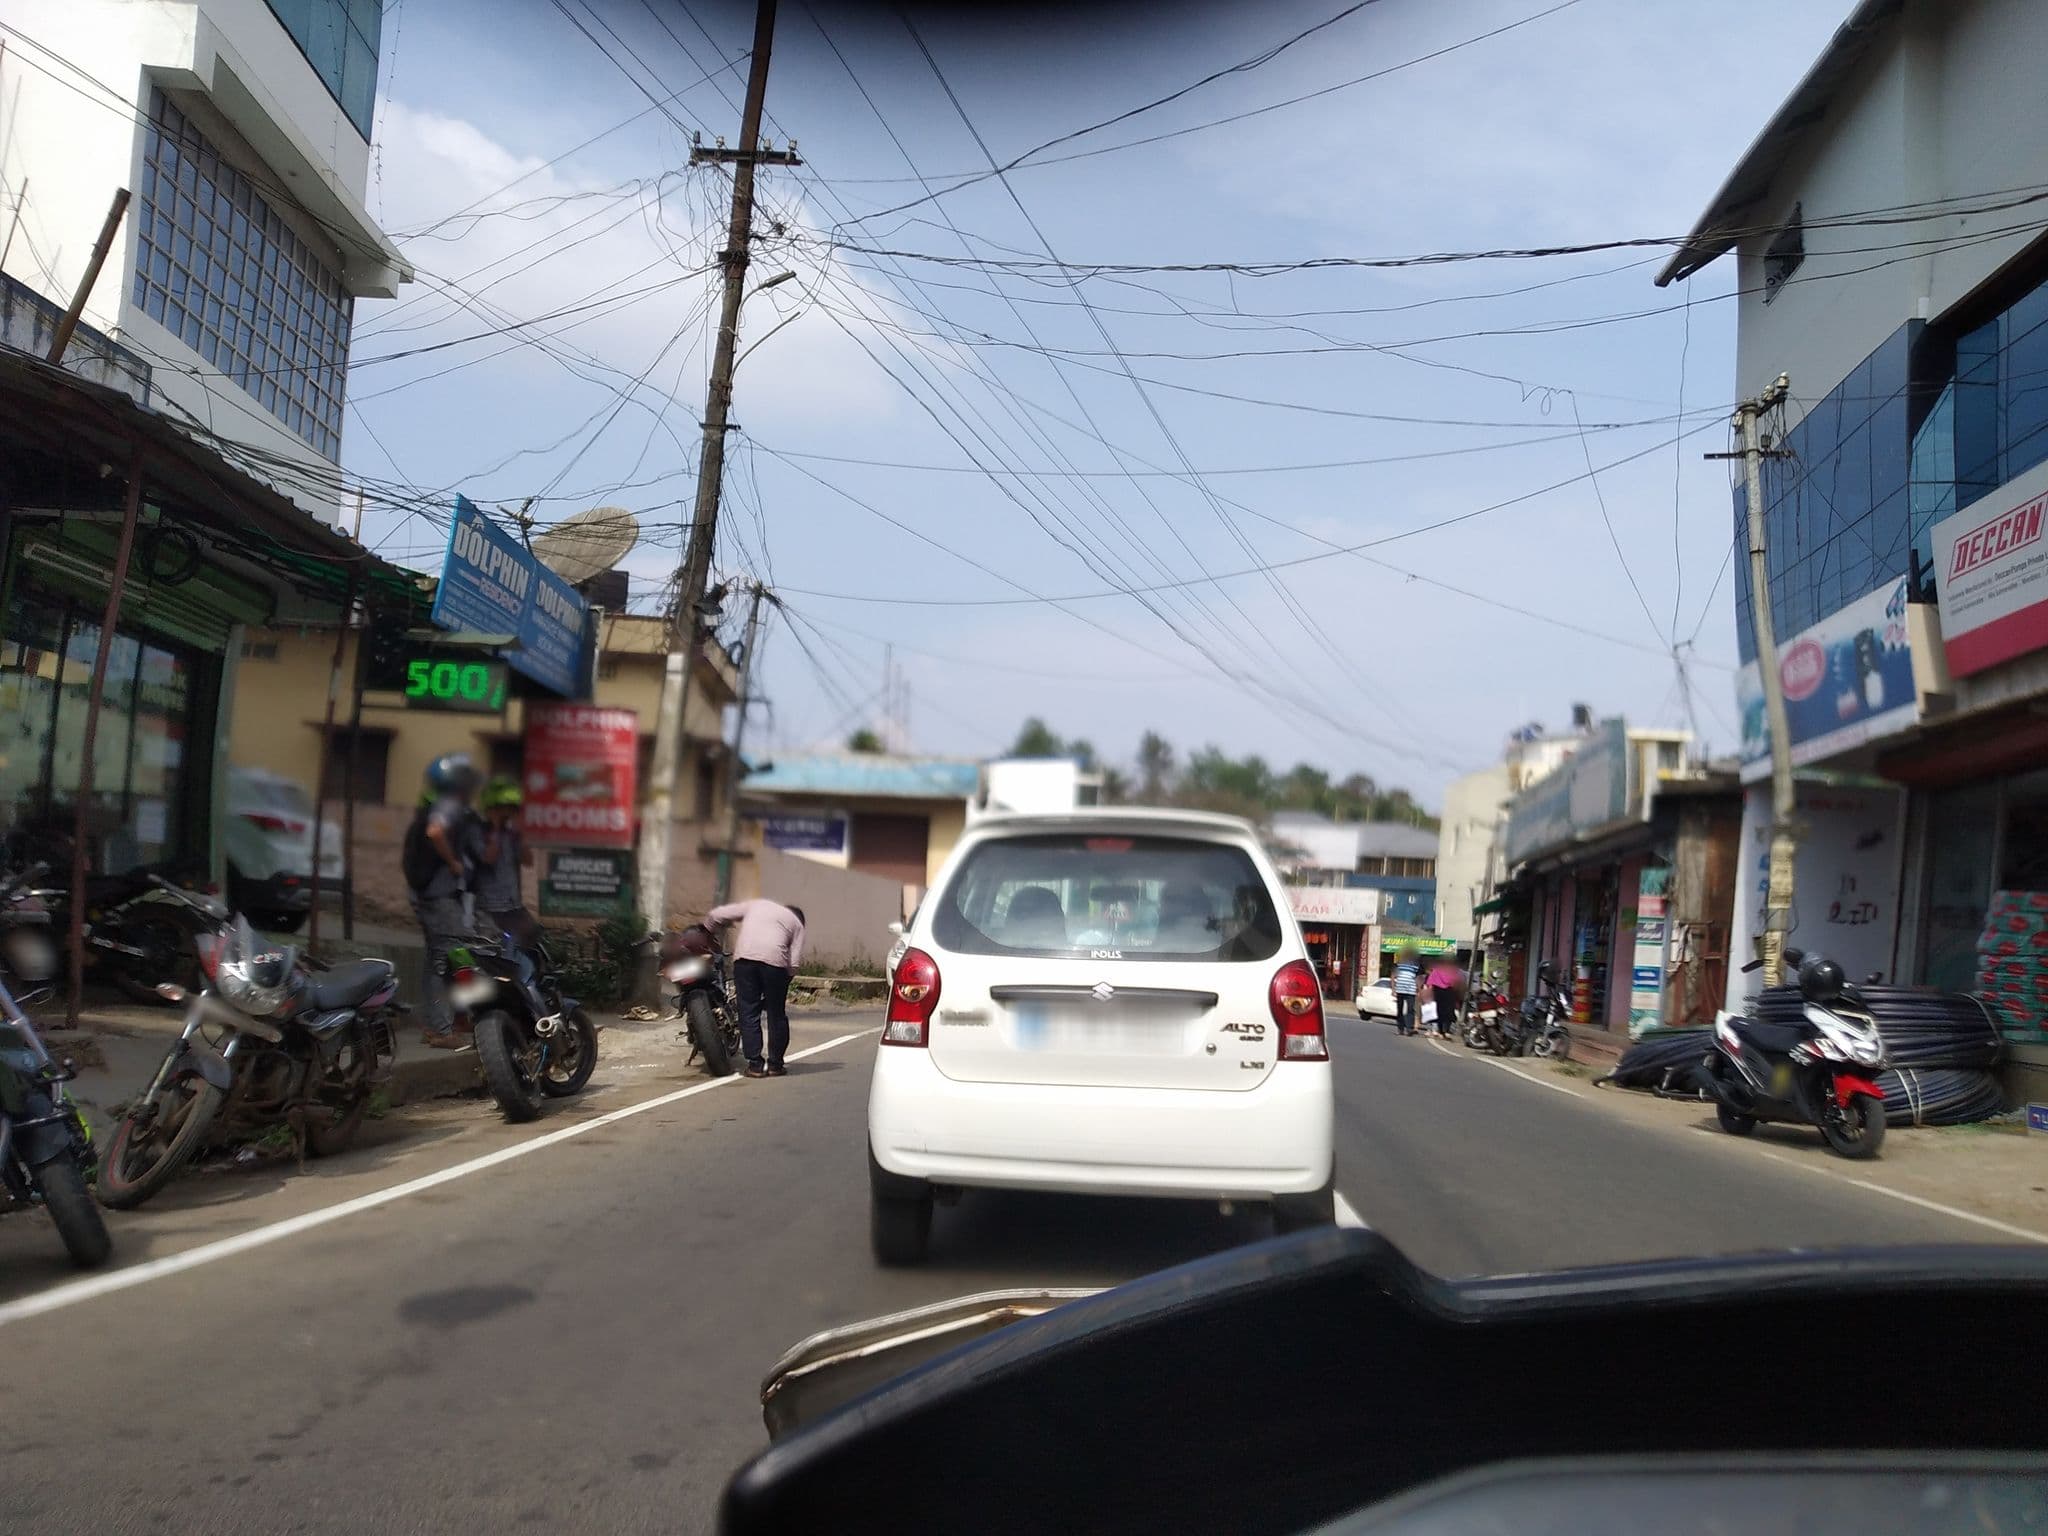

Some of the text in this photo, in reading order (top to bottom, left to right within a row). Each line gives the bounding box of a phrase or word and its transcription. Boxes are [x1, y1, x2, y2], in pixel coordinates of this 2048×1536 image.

[1953, 501, 2043, 574] DECCAN
[453, 521, 530, 601] DOLPHIN
[524, 803, 627, 832] ROOMS
[1090, 949, 1123, 960] INDUS
[1219, 1022, 1266, 1035] ALTO
